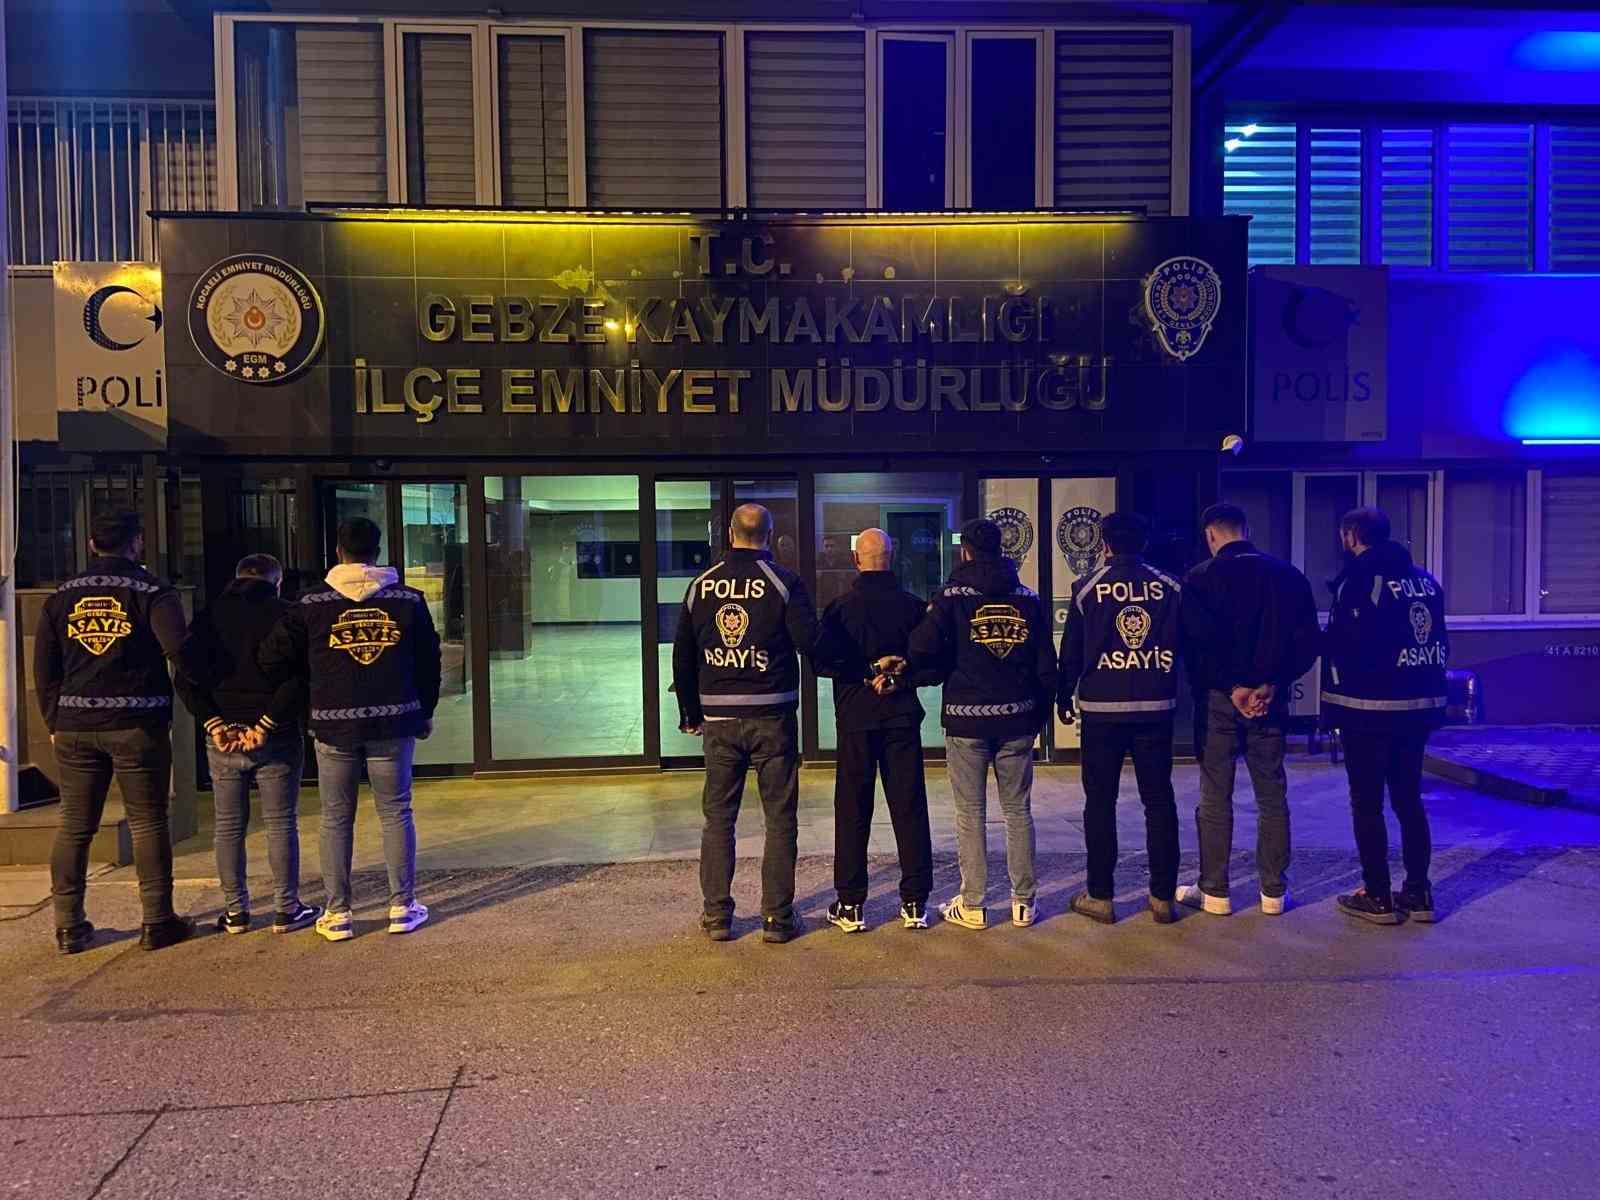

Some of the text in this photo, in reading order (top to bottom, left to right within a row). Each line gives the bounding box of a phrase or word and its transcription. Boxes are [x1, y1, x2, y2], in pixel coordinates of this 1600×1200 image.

[689, 232, 793, 275] T.C.
[195, 260, 312, 310] KOCAELİ EMNİYET MÜDÜRLÜĞÜ
[419, 282, 1050, 344] GEBZE KAYMAKAMLIĞI
[243, 354, 268, 364] EGM
[76, 369, 163, 407] POLİ
[354, 354, 1112, 423] İLÇE EMNİYET MÜDÜRLÜĞÜ
[1272, 360, 1372, 403] POLİS
[701, 578, 766, 600] POLİS
[1095, 581, 1165, 603] POLİS
[1386, 577, 1436, 600] POLİS
[703, 645, 770, 672] ASAYİŞ
[1096, 645, 1174, 673] ASAYİŞ
[1396, 640, 1447, 669] ASAYİŞ
